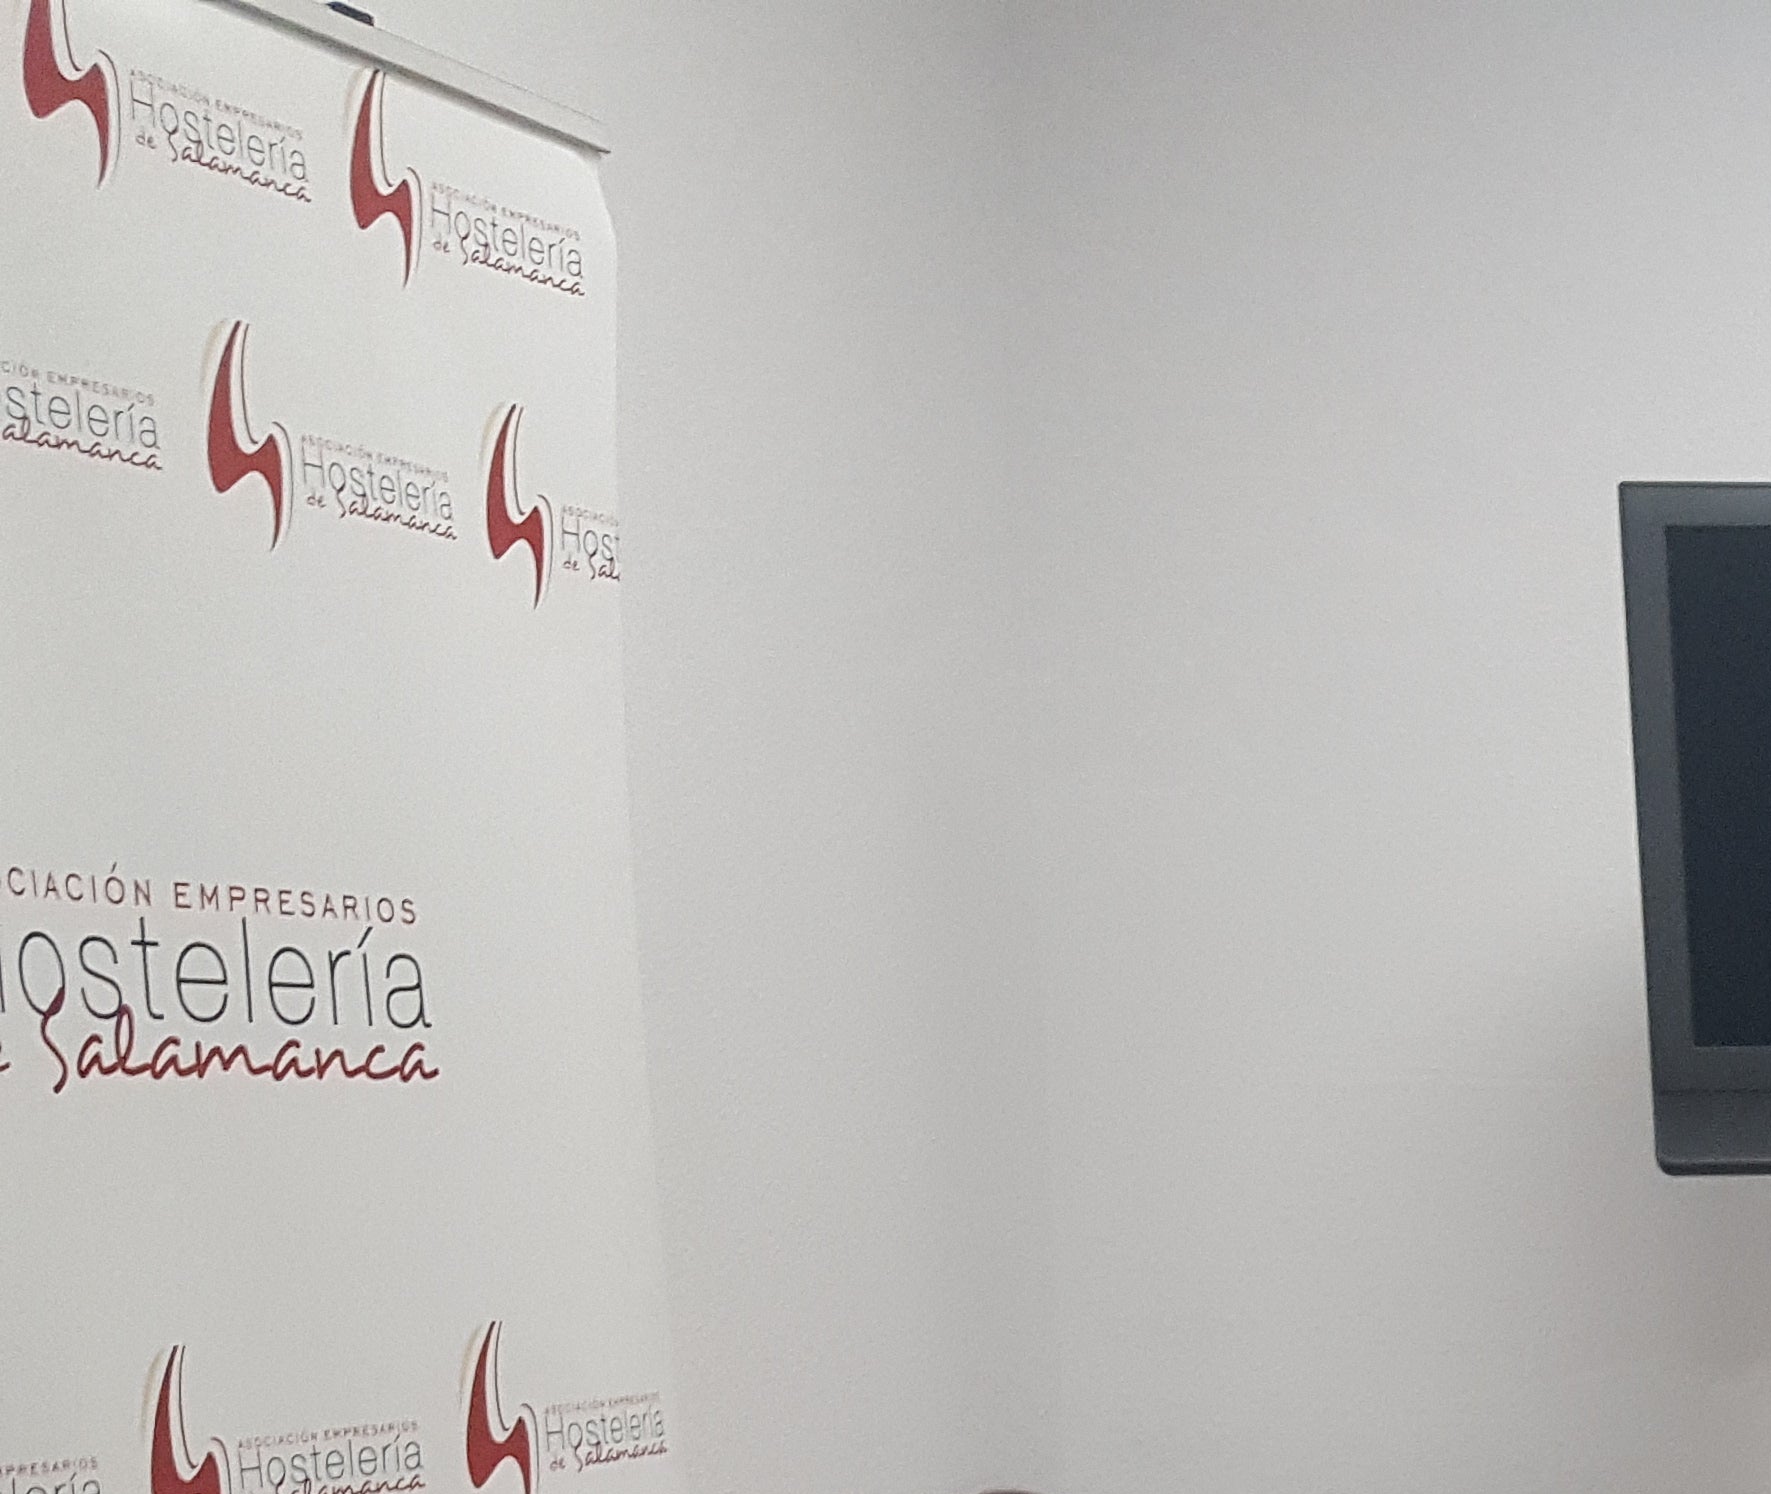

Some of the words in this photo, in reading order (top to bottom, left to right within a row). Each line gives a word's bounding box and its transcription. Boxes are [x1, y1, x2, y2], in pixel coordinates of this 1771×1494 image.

[130, 80, 308, 182] Hostelería
[168, 126, 311, 202] Salamanca
[431, 192, 584, 279] Hostelería
[460, 232, 585, 296] Salamanca
[2, 416, 163, 470] alamanca
[5, 382, 161, 449] stelería
[301, 442, 454, 520] Hostelería
[7, 862, 152, 906] CIACIÓN
[173, 881, 418, 925] EMPRESARIOS
[0, 916, 432, 1029] ostelería
[41, 986, 440, 1094] Salamanca
[238, 1434, 423, 1490] Hostelería
[545, 1405, 665, 1452] Hostelería
